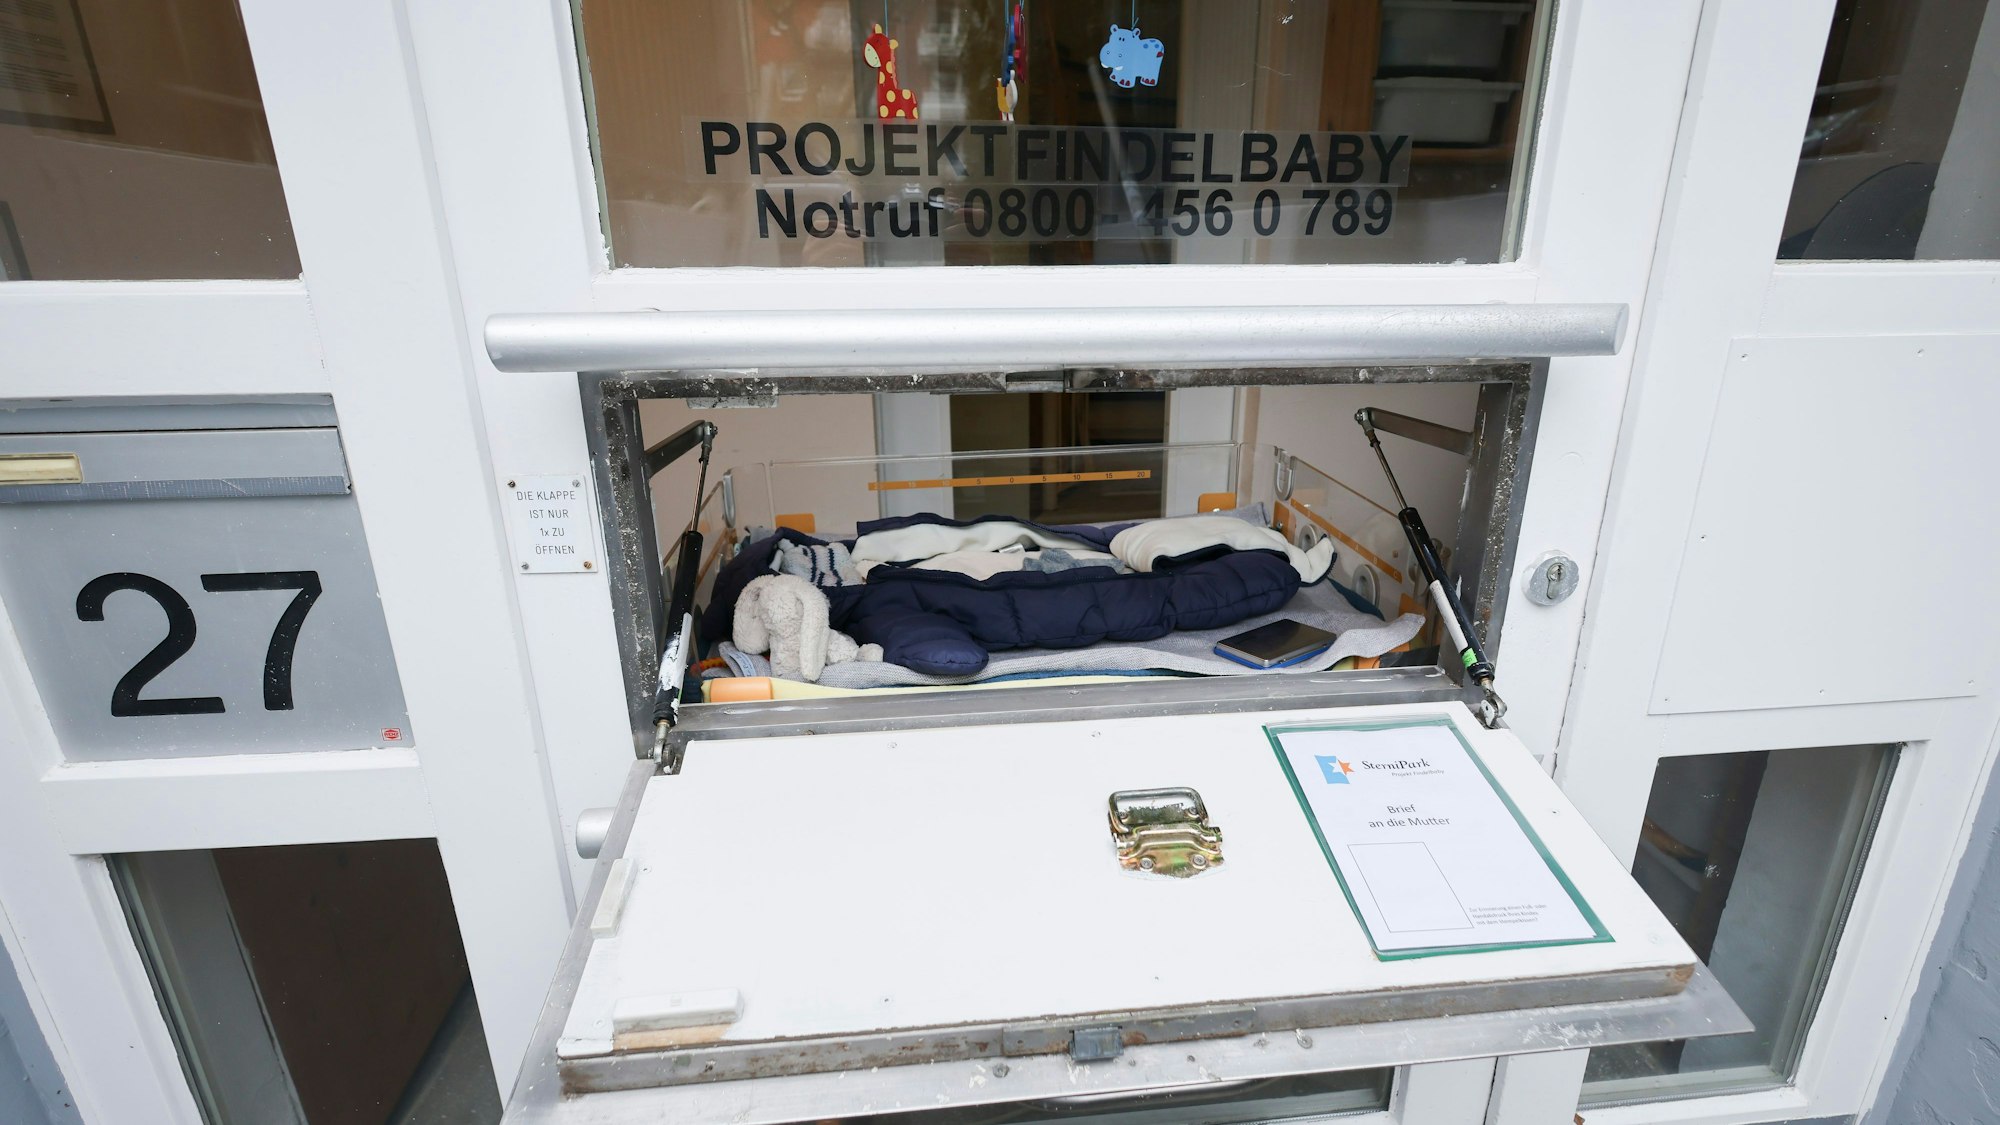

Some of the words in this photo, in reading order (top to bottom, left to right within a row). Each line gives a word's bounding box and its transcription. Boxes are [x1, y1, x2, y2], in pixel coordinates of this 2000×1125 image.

[700, 121, 1008, 177] PROJEKT
[1017, 130, 1409, 184] FINDELBABY
[755, 187, 945, 239] Notruf
[963, 188, 1095, 238] 0800
[1142, 188, 1234, 237] 456
[1253, 188, 1281, 237] 0
[1301, 188, 1393, 237] 789
[516, 491, 533, 500] DIE
[537, 491, 576, 500] KLAPPE
[529, 509, 544, 519] IST
[548, 509, 569, 519] NUR
[539, 527, 550, 537] 1x
[552, 527, 565, 537] ZU
[535, 543, 575, 555] ÖFFNEN
[76, 570, 323, 718] 27
[1361, 758, 1430, 769] SterniPark
[1387, 804, 1416, 813] Brief
[1368, 820, 1385, 828] an
[1386, 818, 1406, 827] die
[1407, 817, 1451, 826] Mutter
